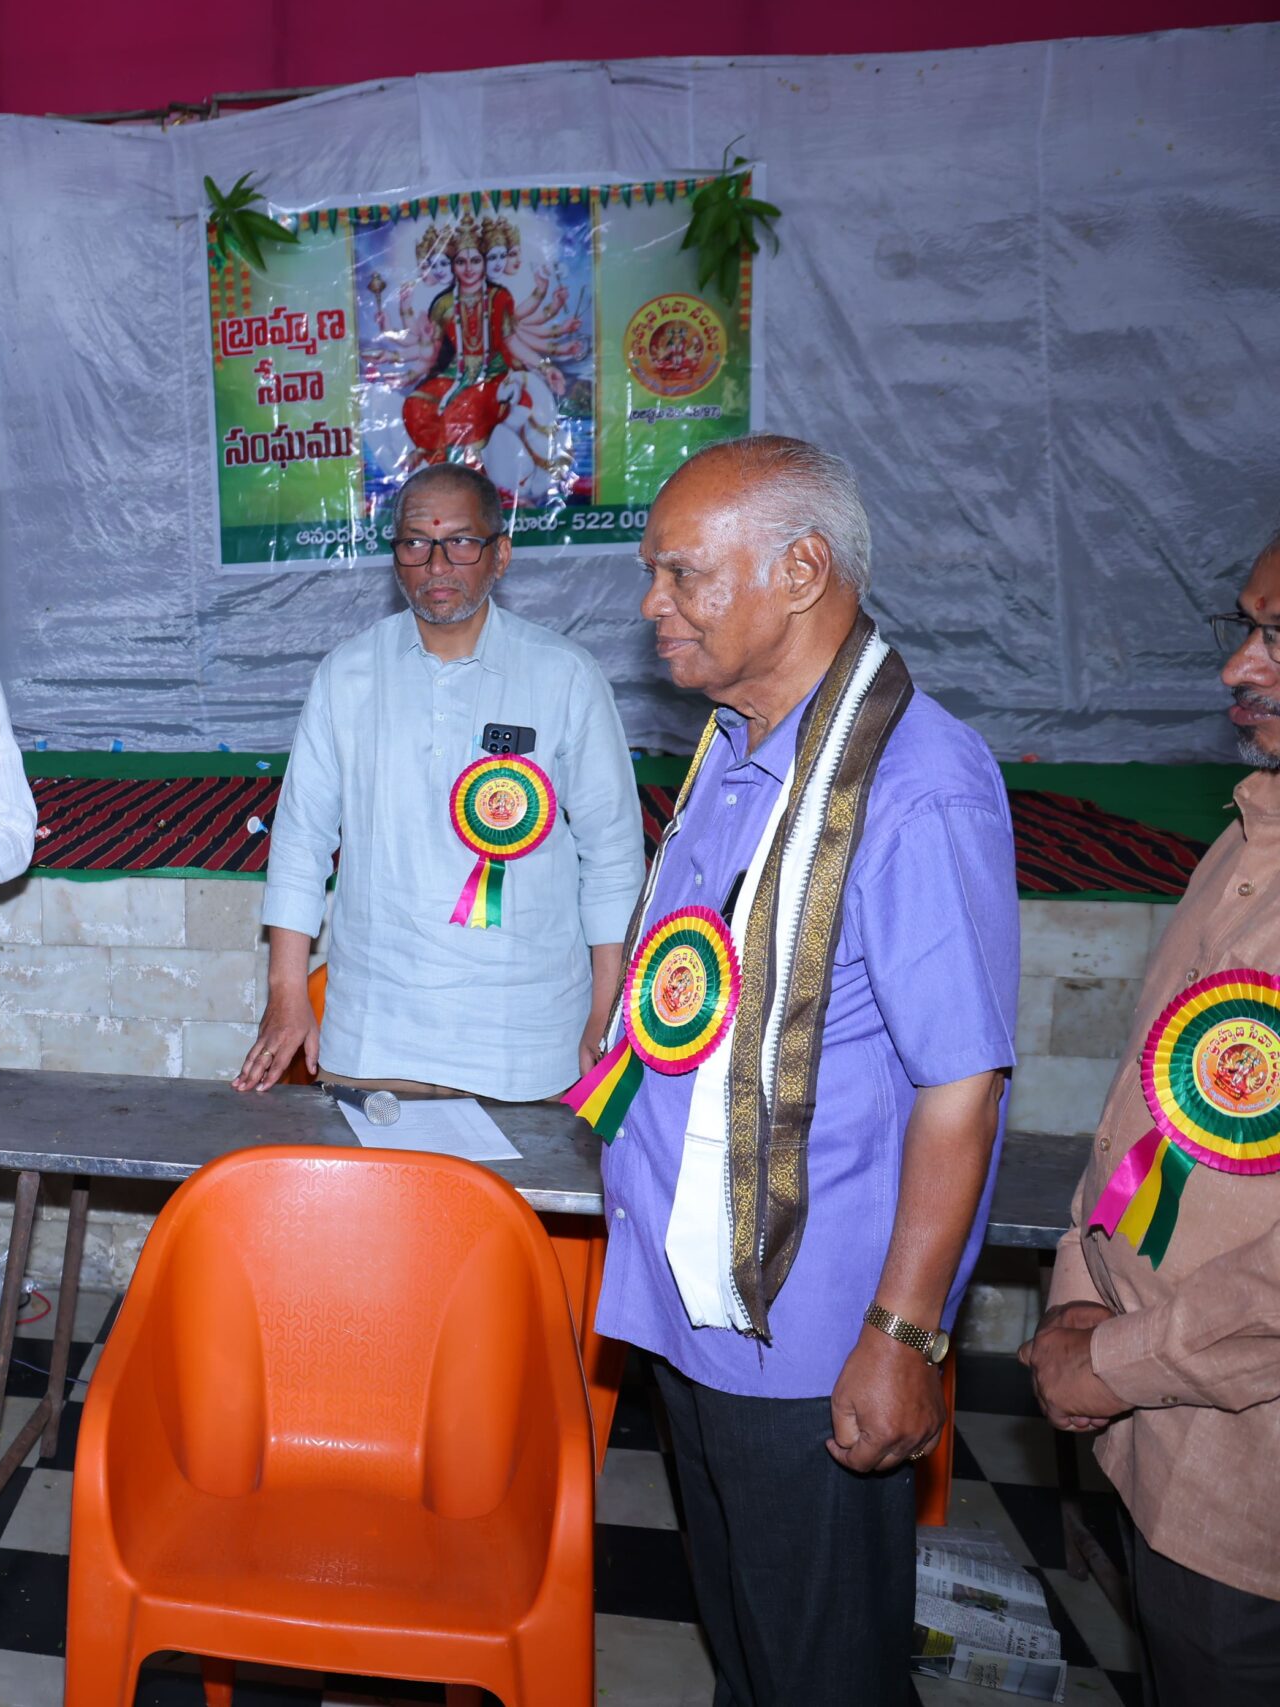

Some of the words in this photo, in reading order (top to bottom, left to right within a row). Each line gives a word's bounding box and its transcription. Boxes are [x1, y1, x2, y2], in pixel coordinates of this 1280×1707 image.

[221, 306, 346, 356] బ్రాహ్మణ
[254, 358, 324, 405] సేవా
[225, 421, 353, 469] సంఘము
[572, 512, 615, 530] 522
[620, 511, 648, 529] 00
